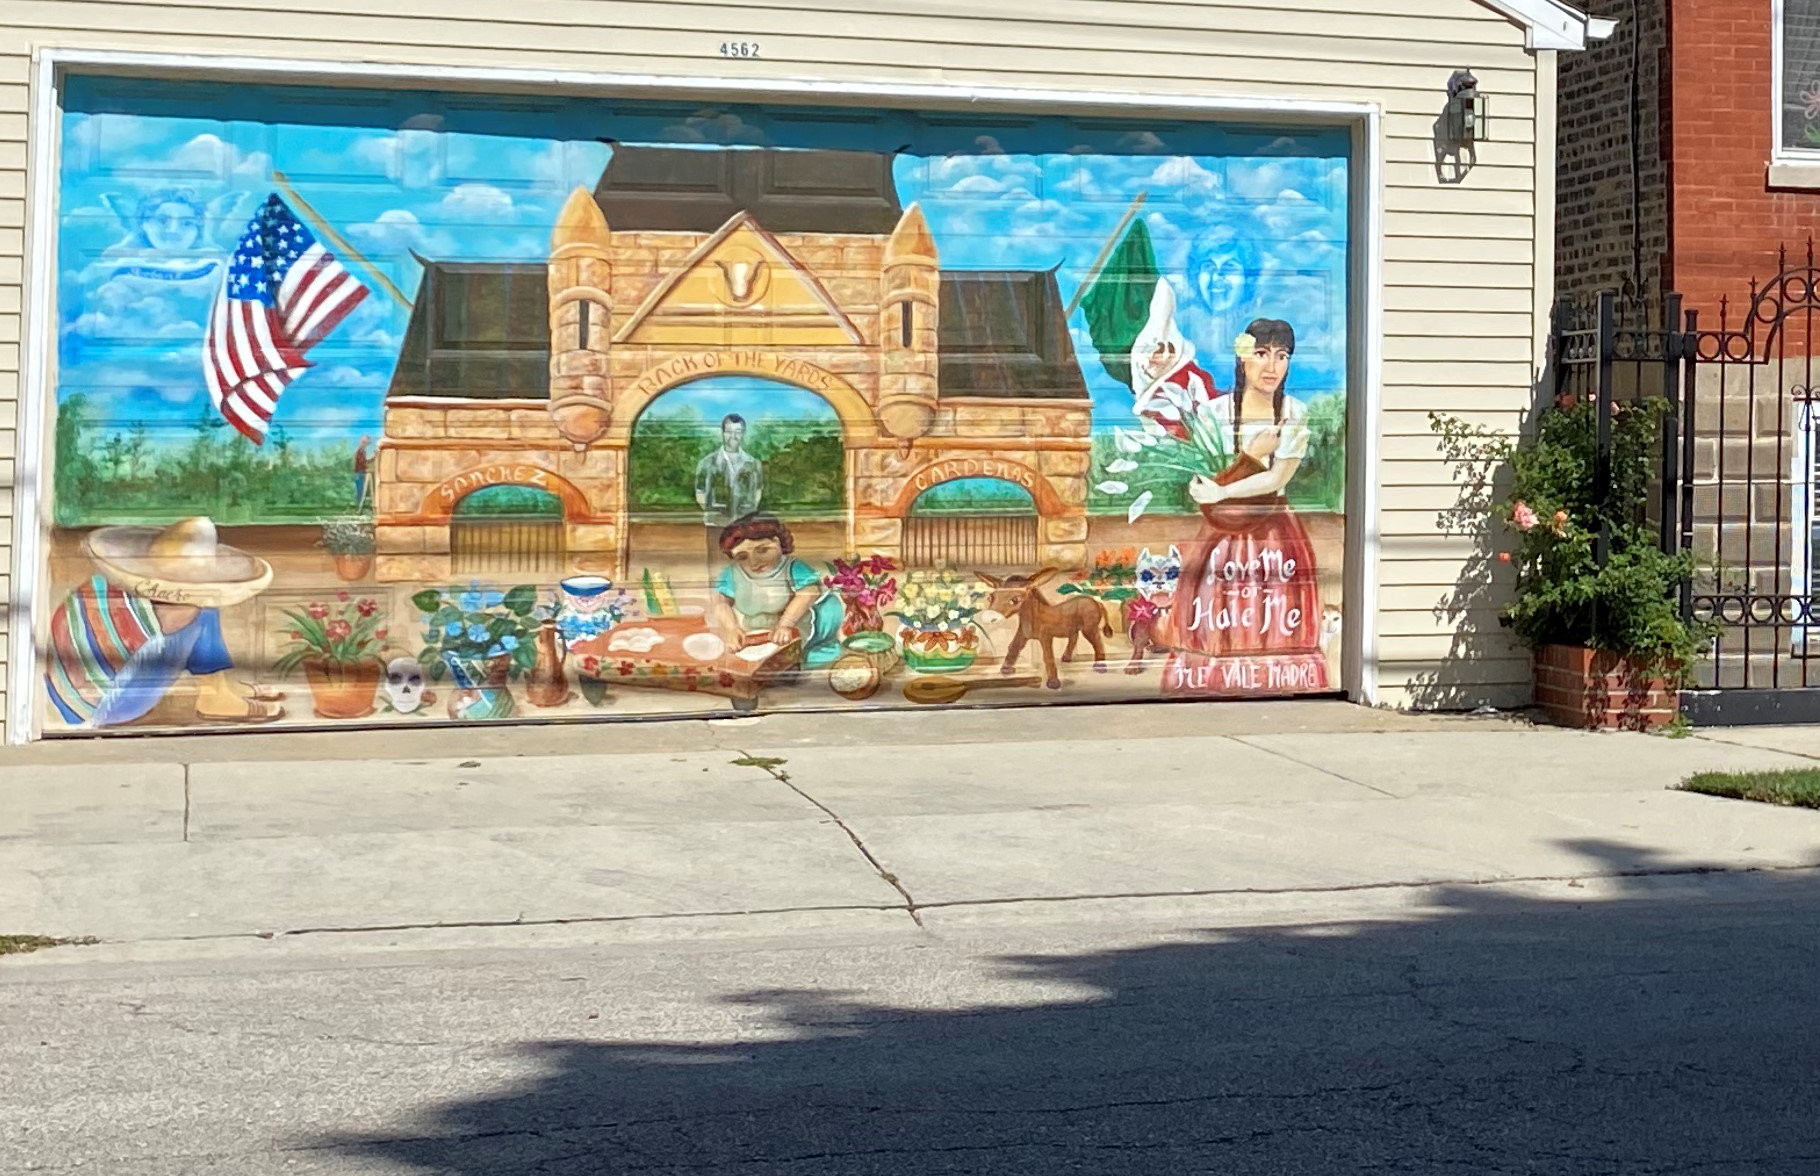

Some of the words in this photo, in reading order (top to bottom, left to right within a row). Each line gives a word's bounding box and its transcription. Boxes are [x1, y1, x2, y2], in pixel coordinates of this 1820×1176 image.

[720, 42, 760, 57] 4562
[638, 355, 698, 395] BACK
[775, 353, 831, 390] YARDS
[441, 466, 548, 502] SANCHEZ
[915, 459, 1035, 491] CARDENAS
[1206, 545, 1260, 585] Love
[1259, 547, 1296, 583] Me
[1187, 596, 1256, 632] Hate
[1259, 594, 1302, 636] Me
[1221, 660, 1263, 690] VALE
